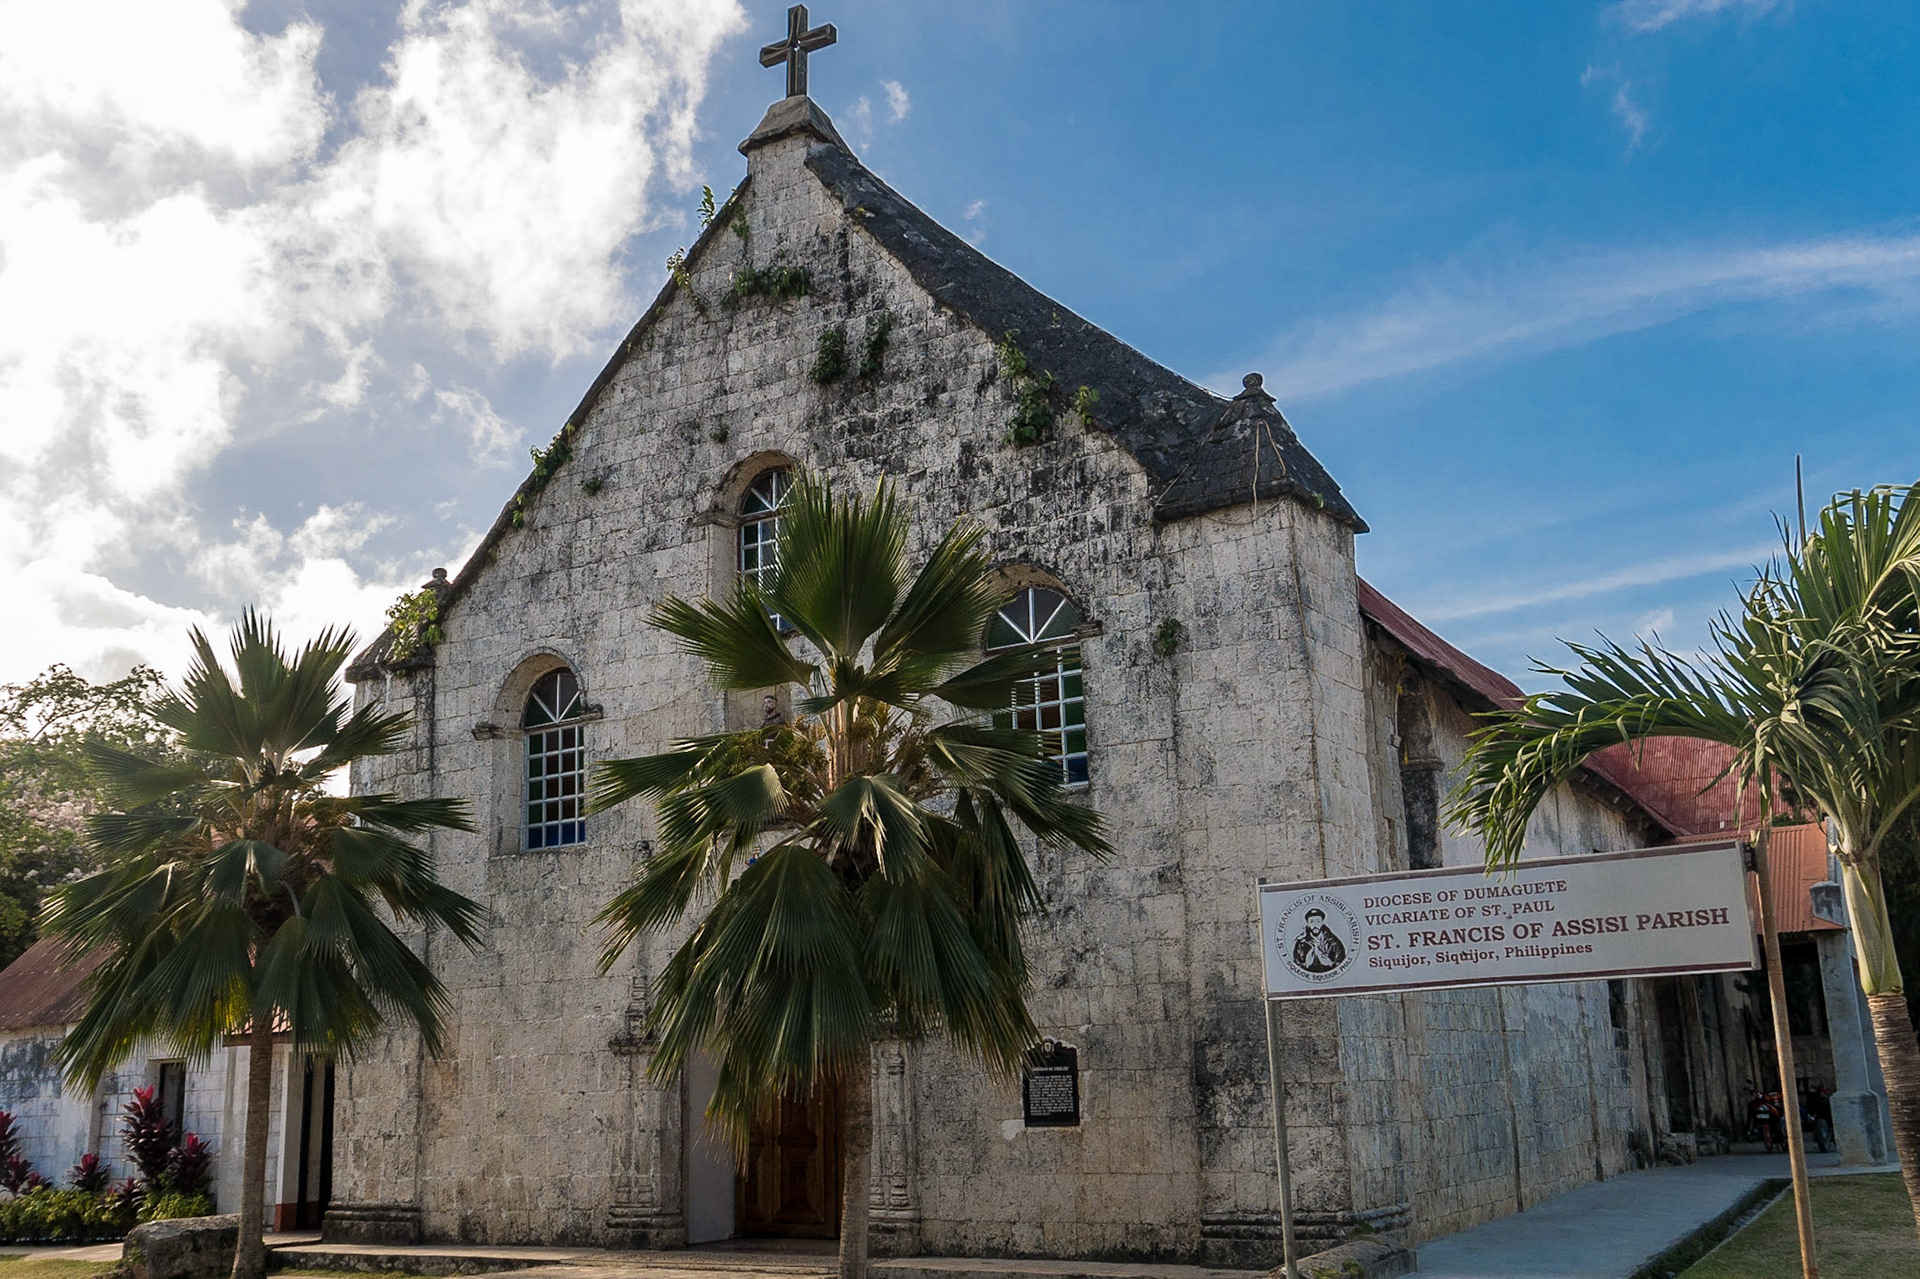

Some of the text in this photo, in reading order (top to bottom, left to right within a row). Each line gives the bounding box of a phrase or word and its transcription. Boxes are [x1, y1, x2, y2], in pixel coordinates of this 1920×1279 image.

[1364, 880, 1567, 908] DIOCESE OF DUMAGUETE
[1279, 899, 1302, 933] FRANCIS
[1304, 895, 1316, 903] OF
[1319, 895, 1346, 912] ASSISI
[1345, 911, 1359, 945] PARISH
[1365, 900, 1555, 926] VICARIATE OF ST. PAUL
[1368, 908, 1729, 950] ST. FRANCIS OF ASSISI PARISH
[1369, 944, 1593, 970] Siquijor, Siquijor, Philippines
